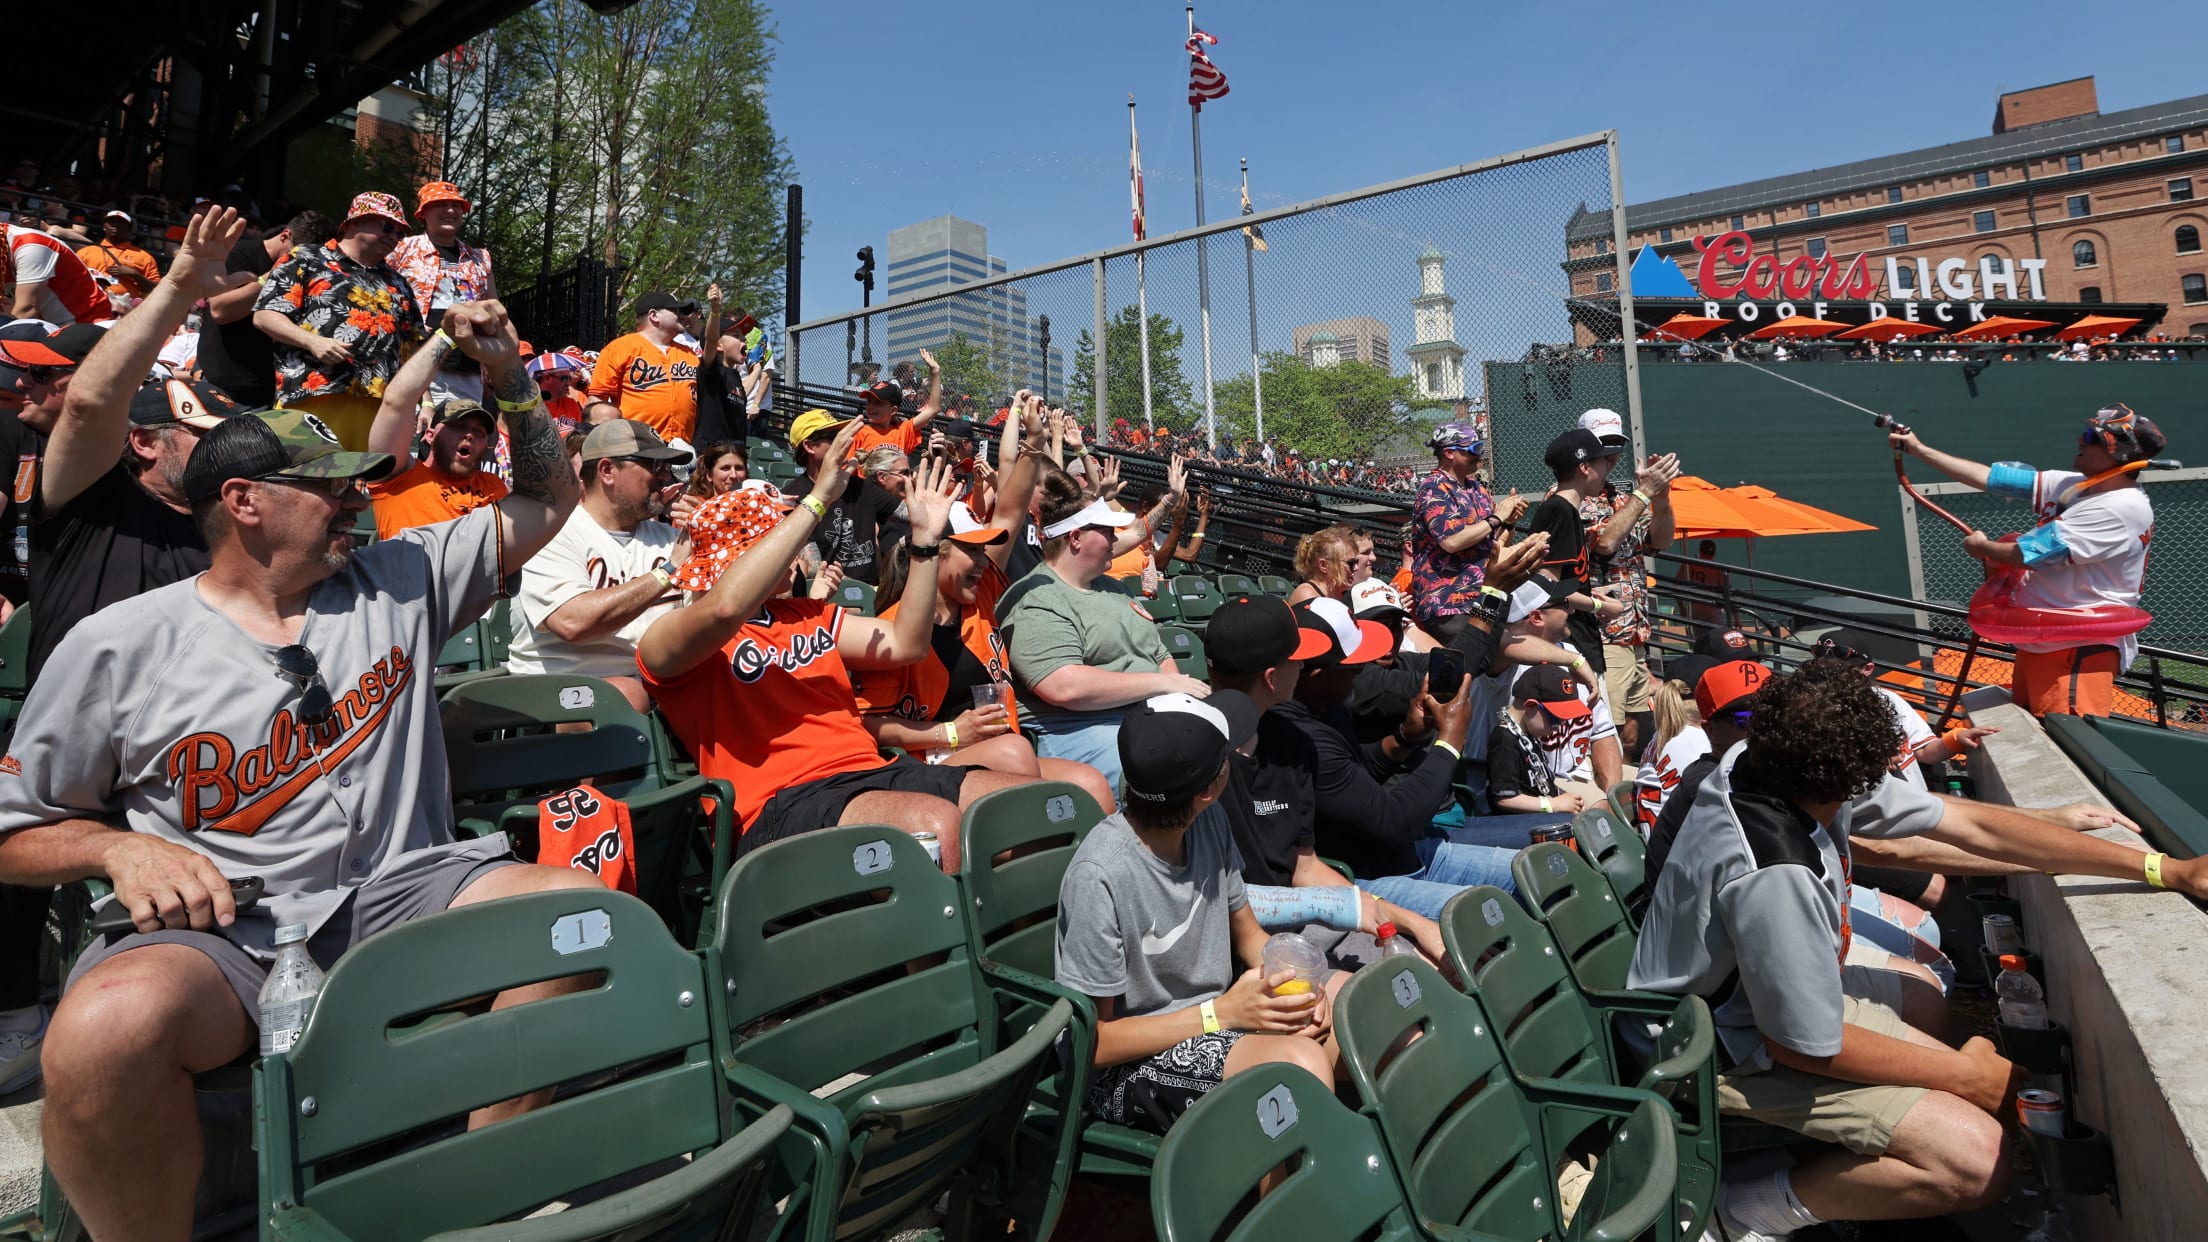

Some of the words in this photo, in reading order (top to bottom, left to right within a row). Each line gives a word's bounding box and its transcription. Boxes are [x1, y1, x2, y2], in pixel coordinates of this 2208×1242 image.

[1691, 230, 1877, 300] Coors
[1885, 256, 2049, 301] LIGHT
[1704, 301, 1828, 322] ROOF
[1869, 302, 1994, 322] DECK
[1739, 663, 1760, 687] B
[571, 690, 583, 705] 2
[1055, 800, 1066, 818] 3
[866, 847, 880, 869] 2
[1489, 903, 1498, 921] 4
[576, 918, 587, 945] 1
[1400, 979, 1412, 1001] 3
[1268, 1096, 1286, 1127] 2
